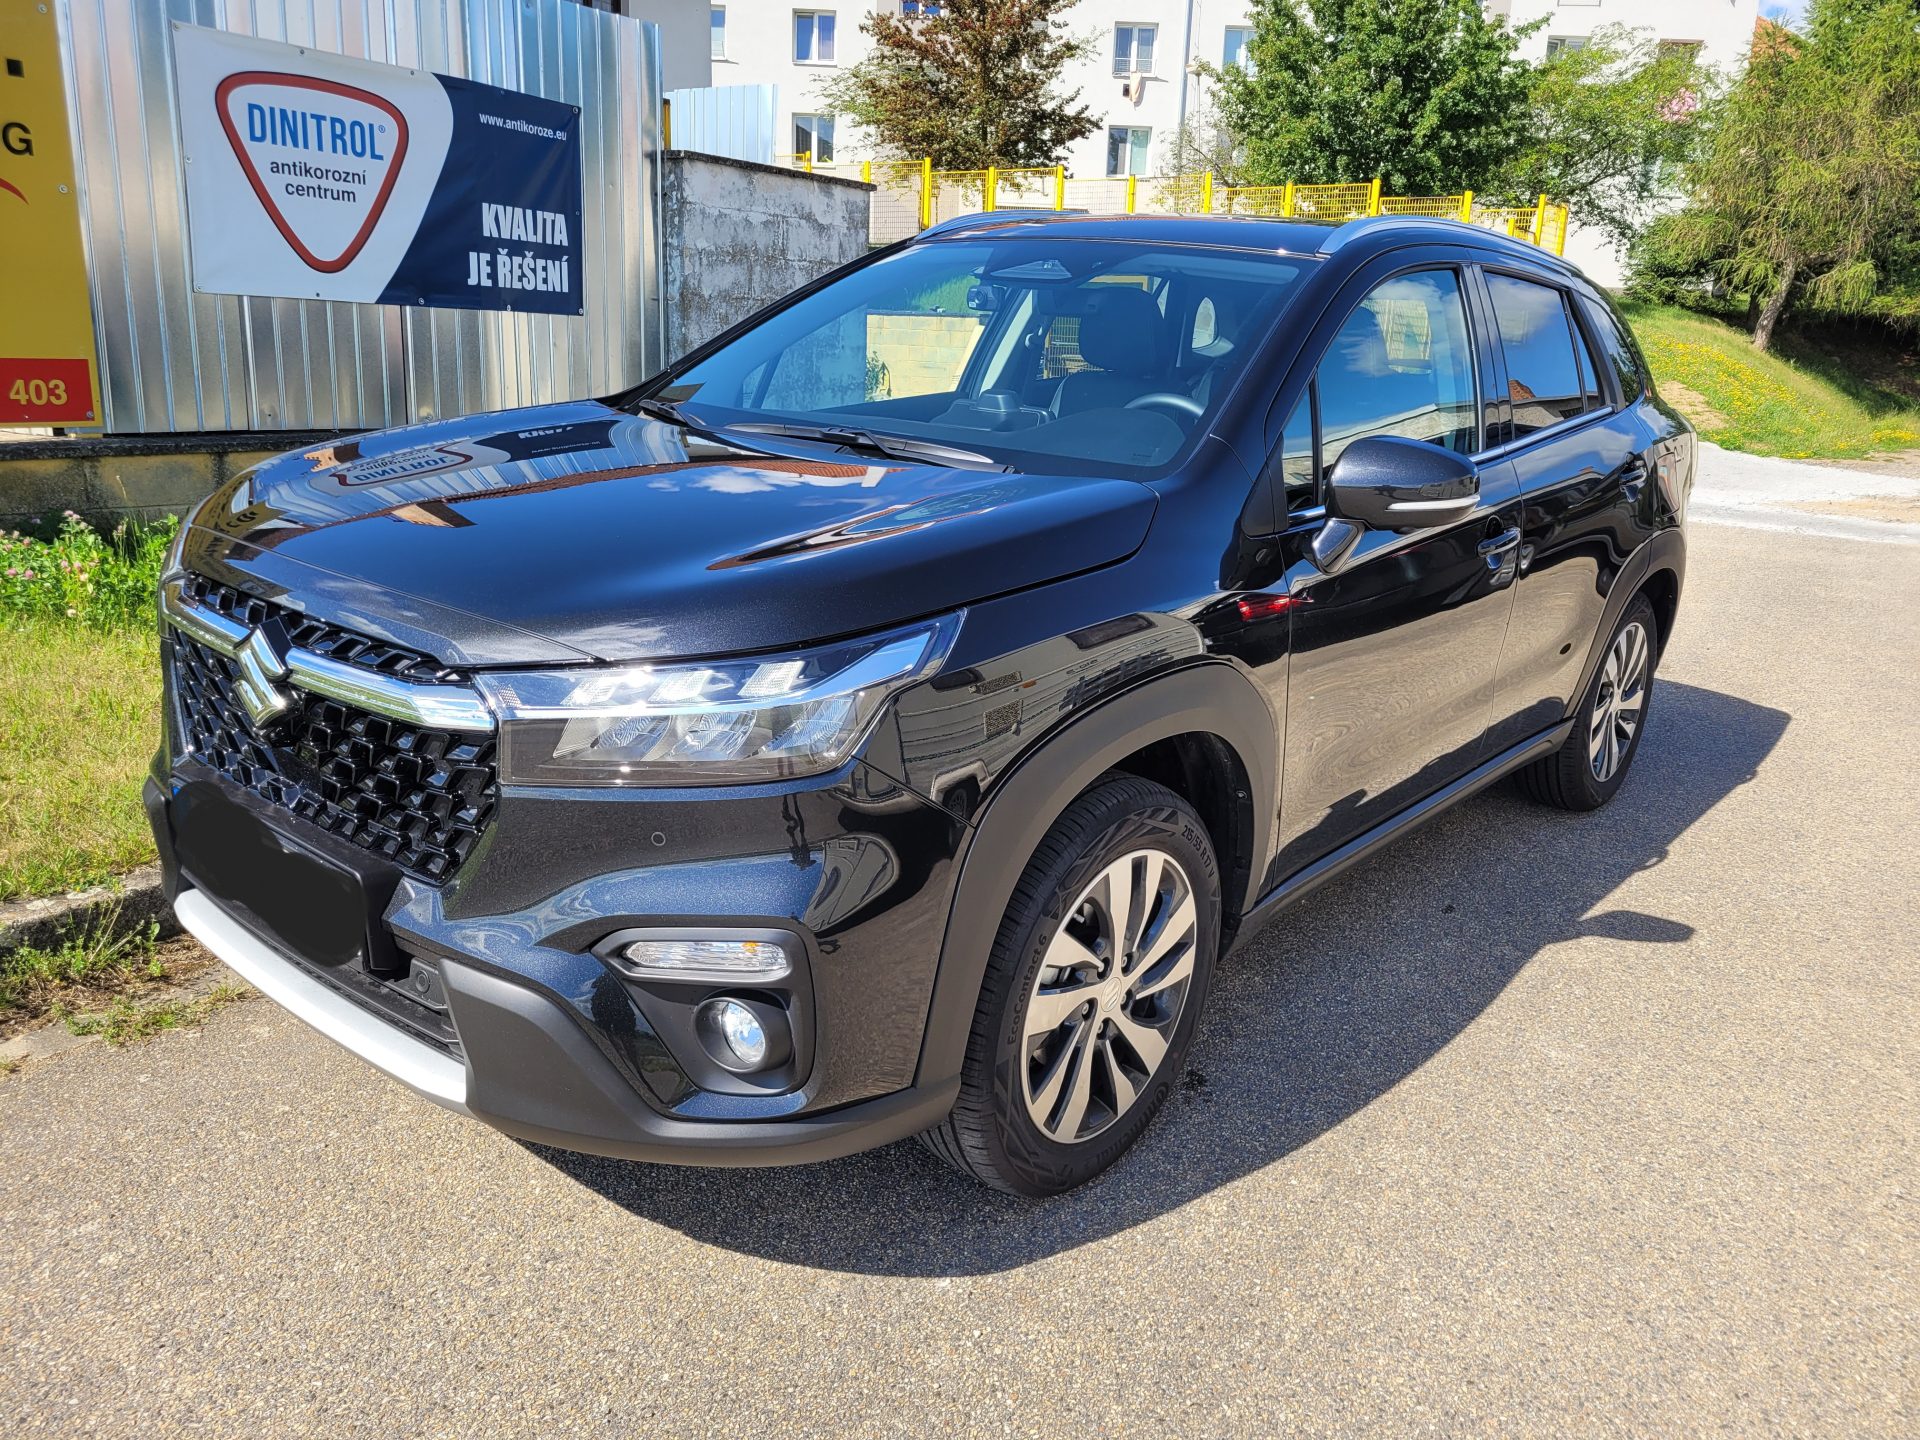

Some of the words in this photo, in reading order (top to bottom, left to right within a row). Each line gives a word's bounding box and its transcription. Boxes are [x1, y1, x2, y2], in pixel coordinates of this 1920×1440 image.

[2, 122, 34, 156] G
[479, 113, 567, 141] www.antikoroze.eu
[270, 161, 367, 185] antikorozní
[285, 183, 356, 203] centrum
[482, 202, 568, 246] KVALITA
[467, 251, 492, 287] JE
[497, 248, 569, 293] ŘEŠENÍ
[9, 379, 68, 406] 403
[1181, 824, 1203, 852] 215/55
[1007, 948, 1042, 1045] EcoContact
[1038, 933, 1047, 946] 6
